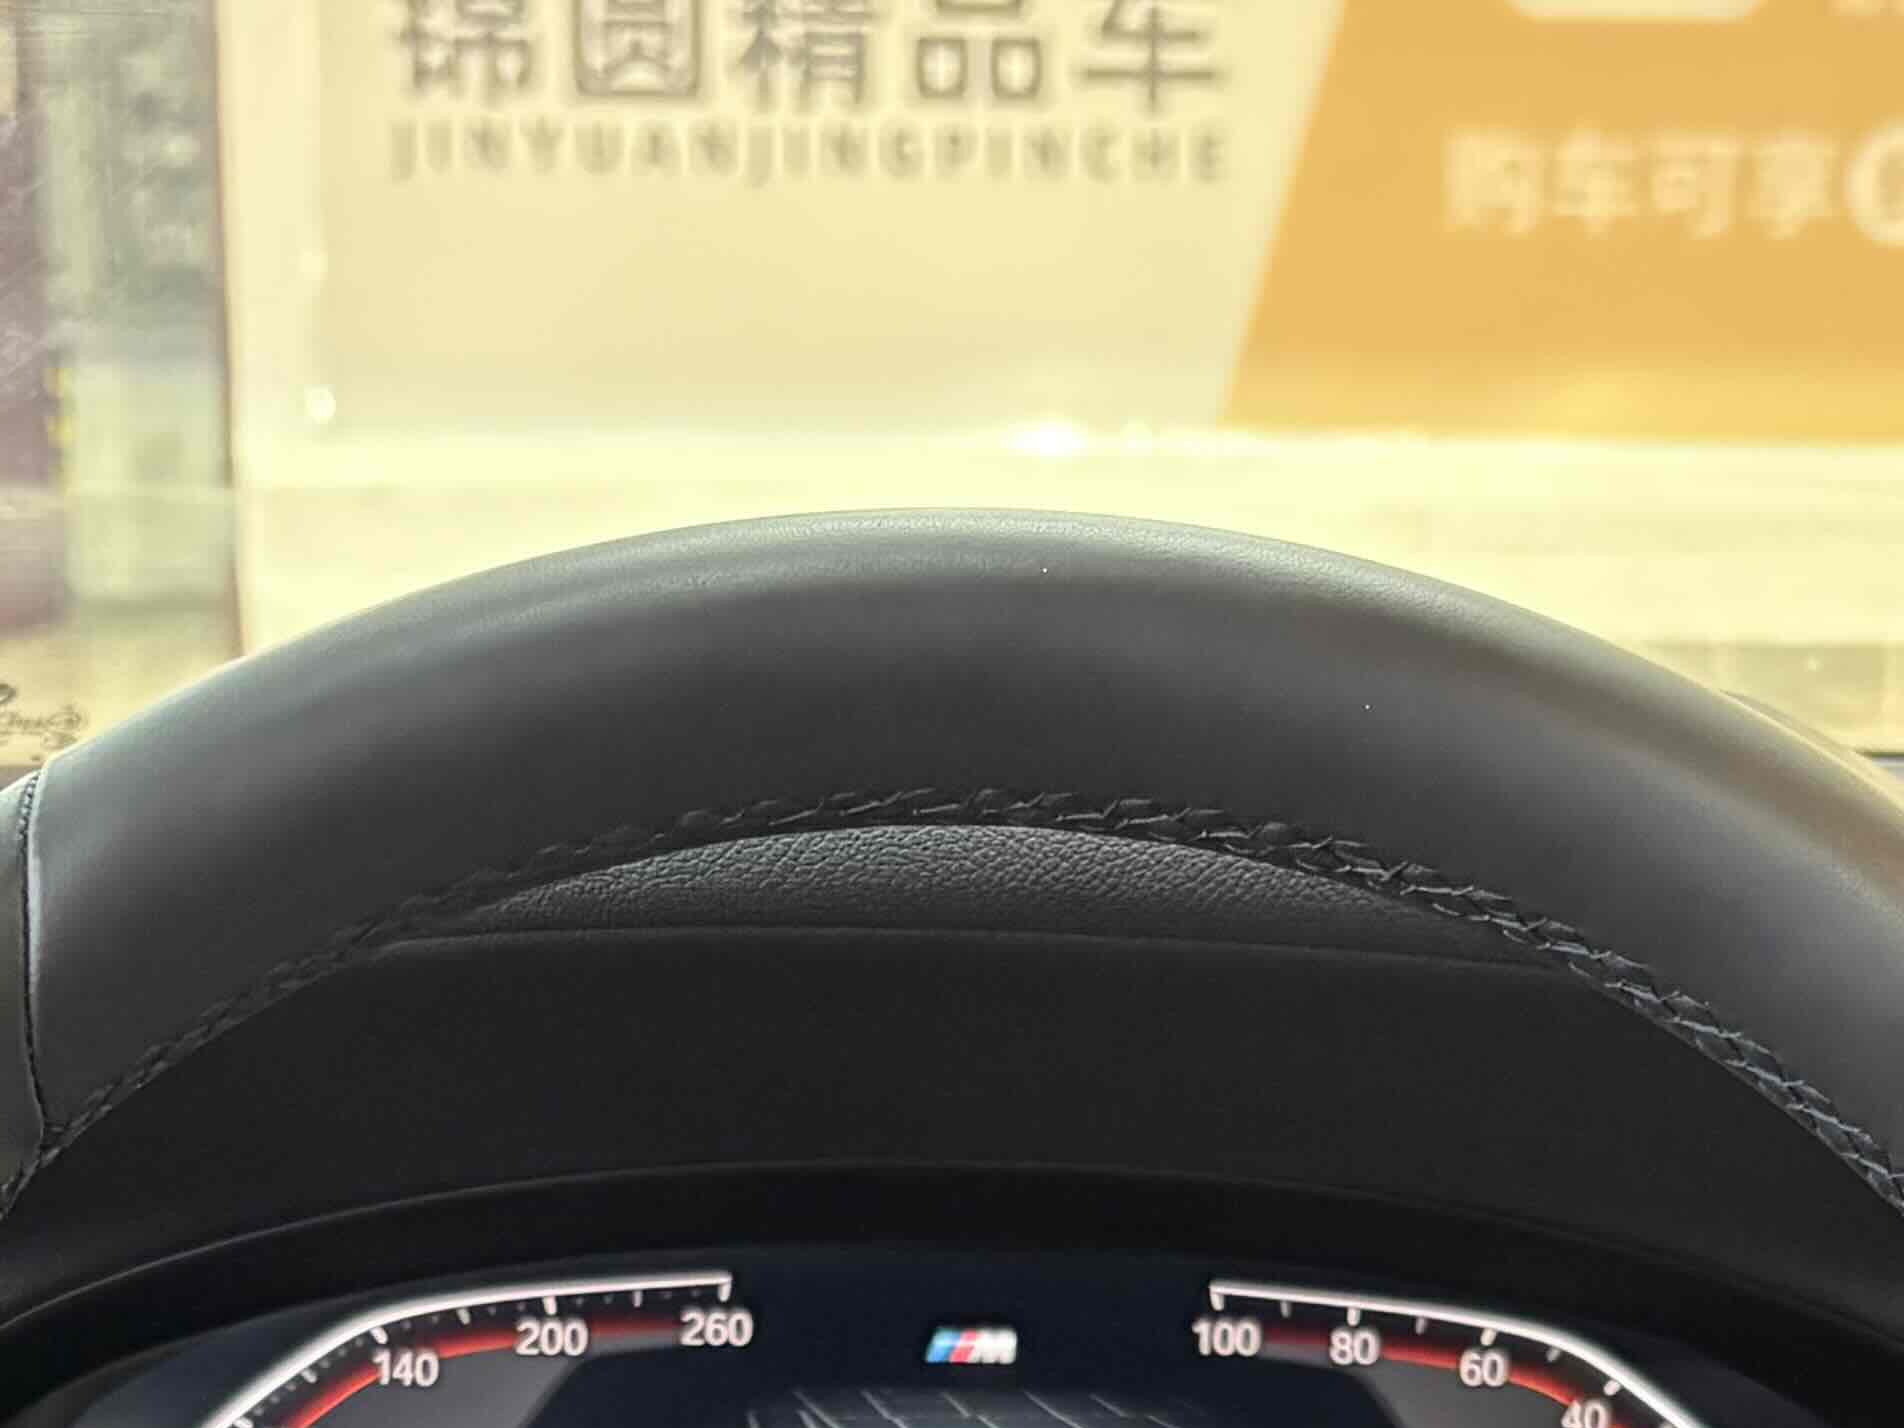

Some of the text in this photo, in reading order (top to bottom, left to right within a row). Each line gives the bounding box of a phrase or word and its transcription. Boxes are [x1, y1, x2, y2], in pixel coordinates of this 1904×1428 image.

[516, 1317, 589, 1357] 200
[679, 1311, 753, 1348] 260
[1193, 1319, 1261, 1357] 100
[1329, 1327, 1380, 1366] 80
[373, 1349, 440, 1388] 140
[1459, 1350, 1508, 1388] 60
